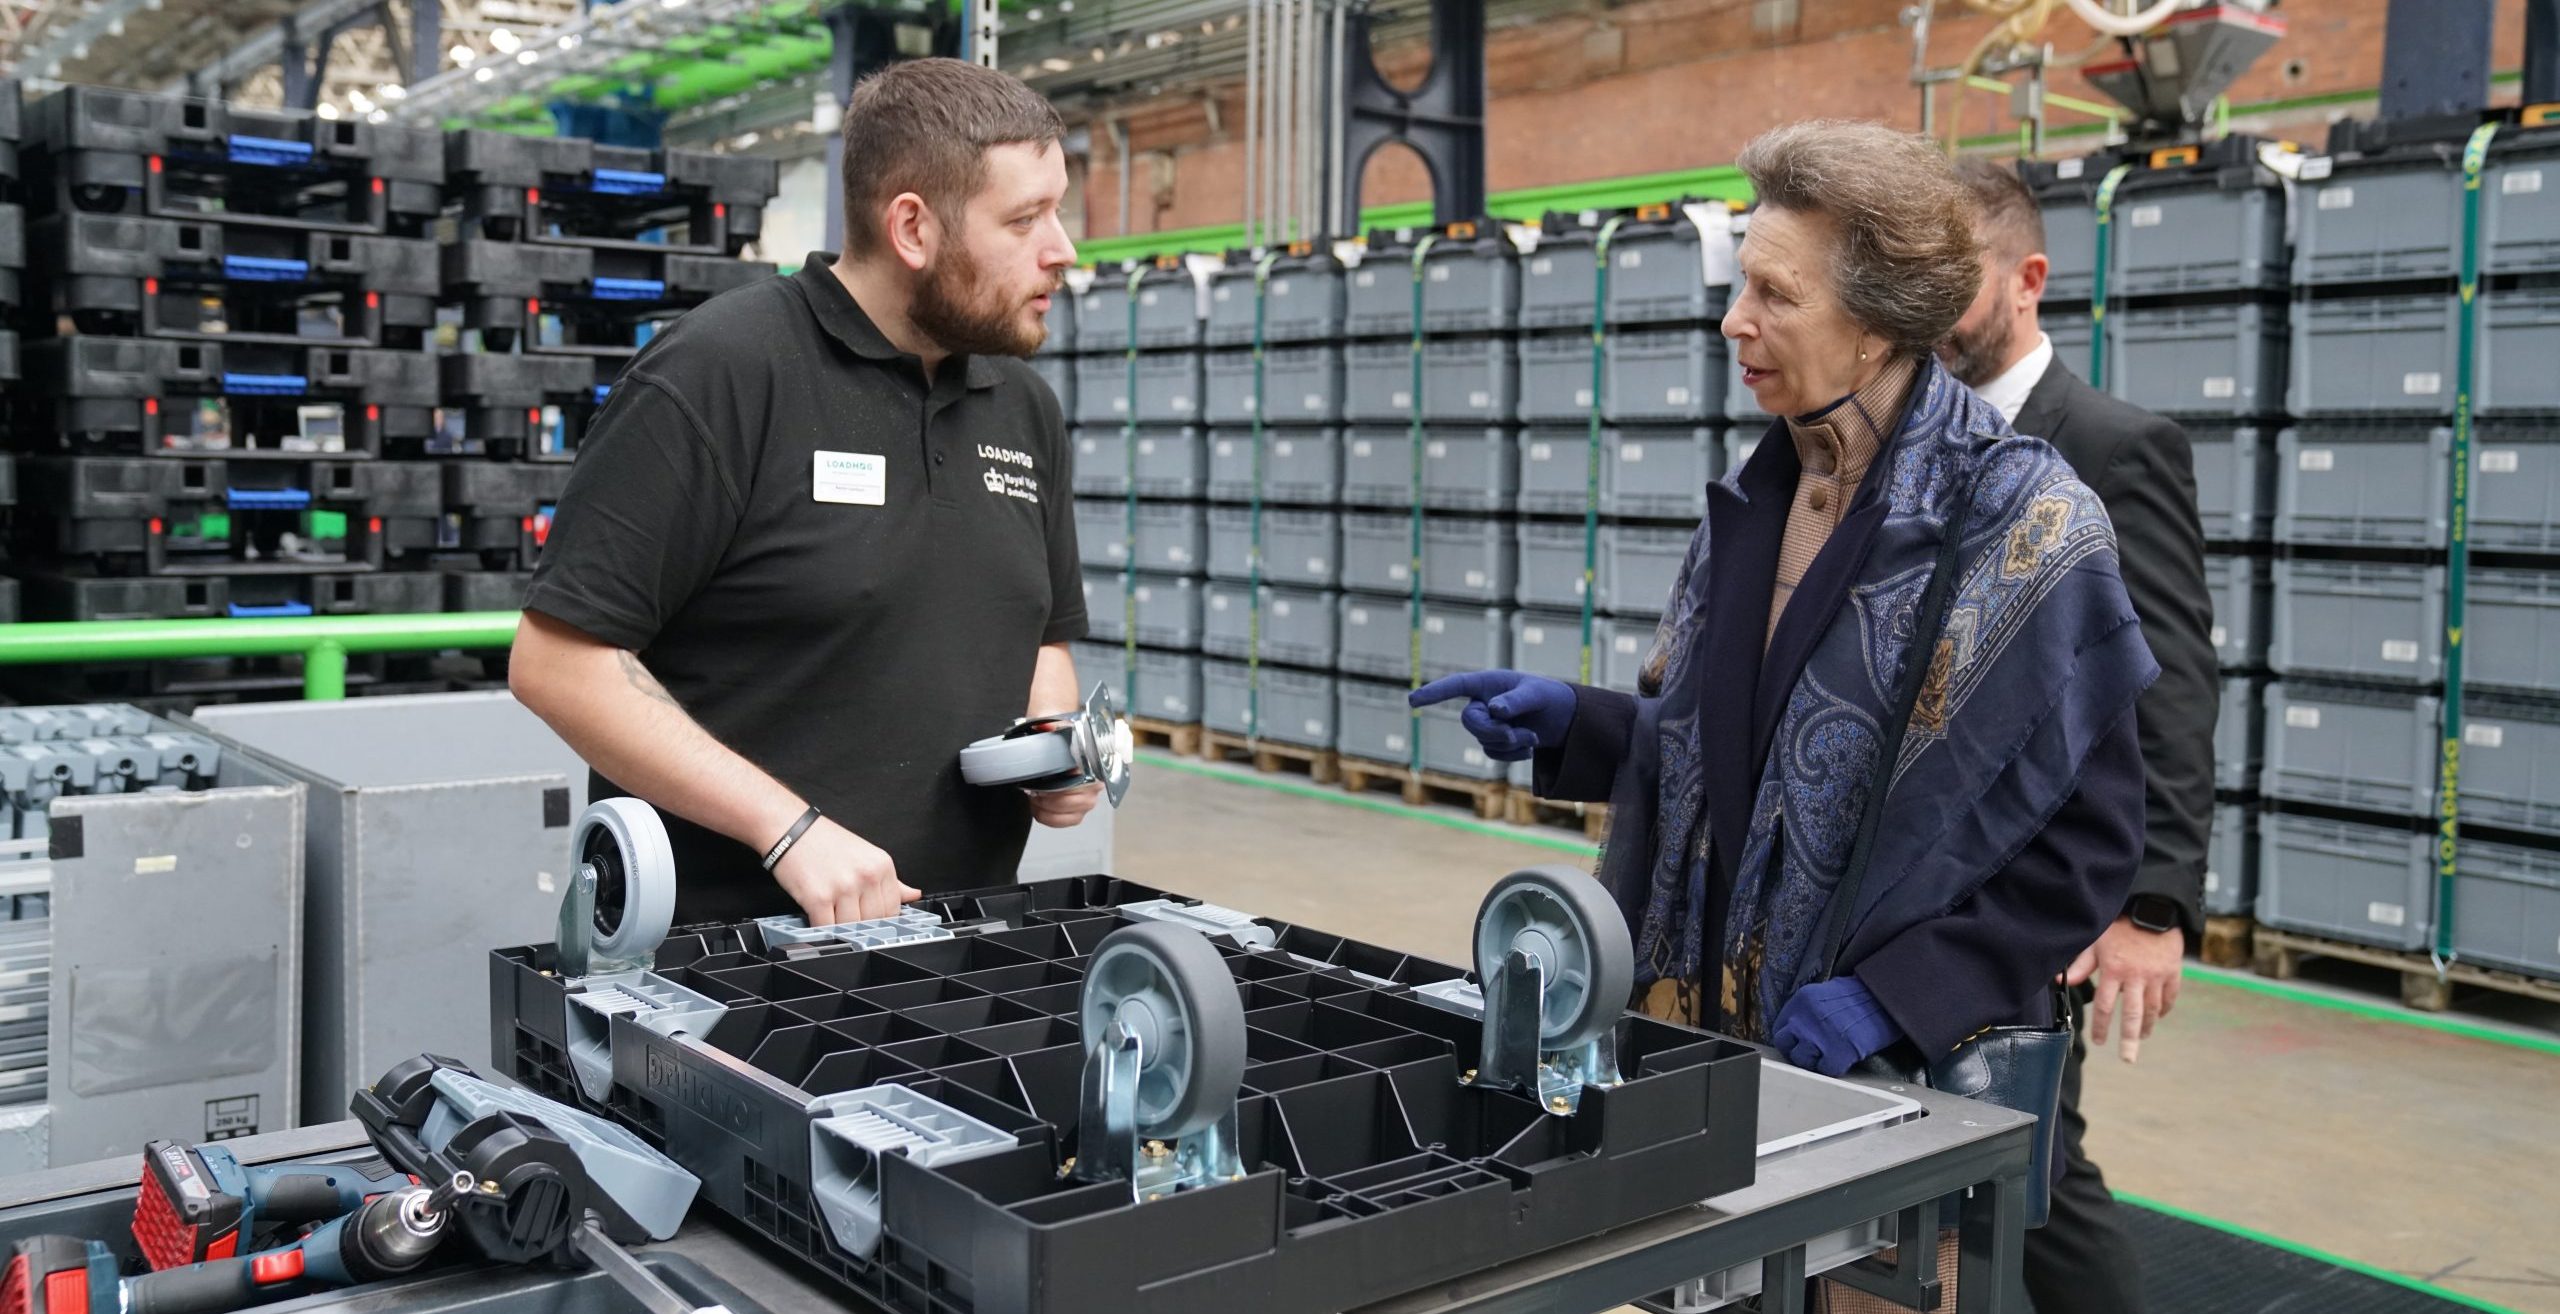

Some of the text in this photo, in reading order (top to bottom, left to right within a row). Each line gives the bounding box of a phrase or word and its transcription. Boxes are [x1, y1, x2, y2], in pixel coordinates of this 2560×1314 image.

[826, 460, 873, 471] LOADHOG
[977, 443, 1033, 469] LOADHOG
[2440, 738, 2459, 876] LOADHOG
